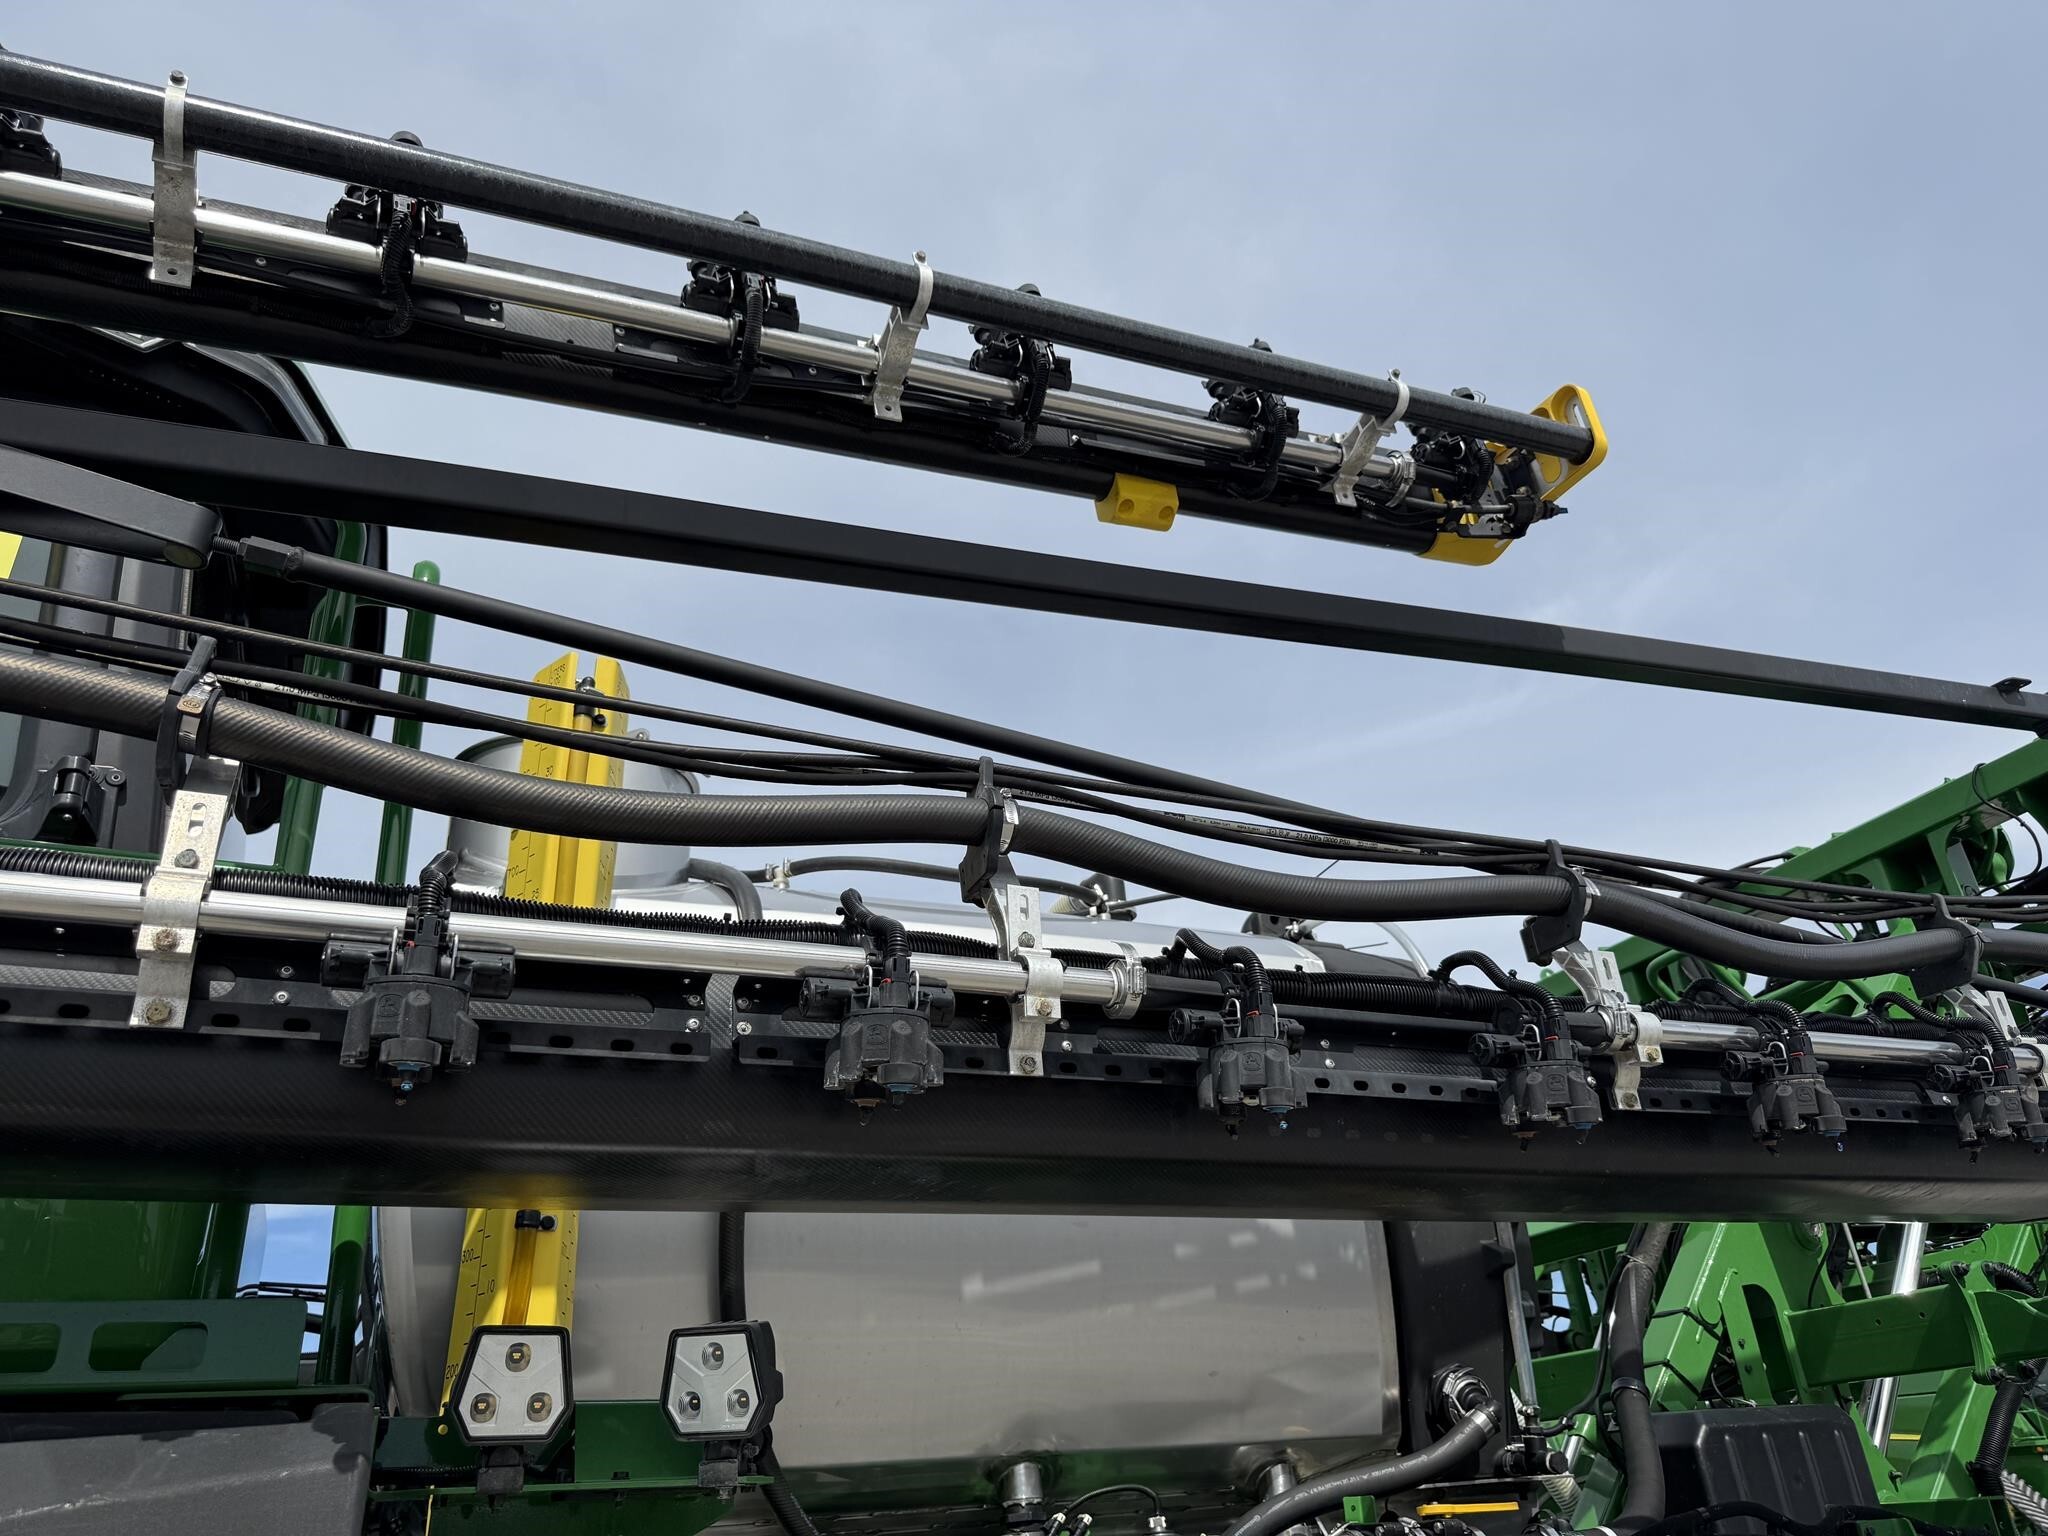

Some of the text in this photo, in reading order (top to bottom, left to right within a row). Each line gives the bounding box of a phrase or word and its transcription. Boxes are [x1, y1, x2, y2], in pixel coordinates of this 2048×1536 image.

[1295, 831, 1308, 840] 21.0
[1308, 833, 1322, 842] MPa
[461, 1248, 474, 1264] 300
[486, 1279, 496, 1294] 10
[445, 1363, 459, 1380] 200
